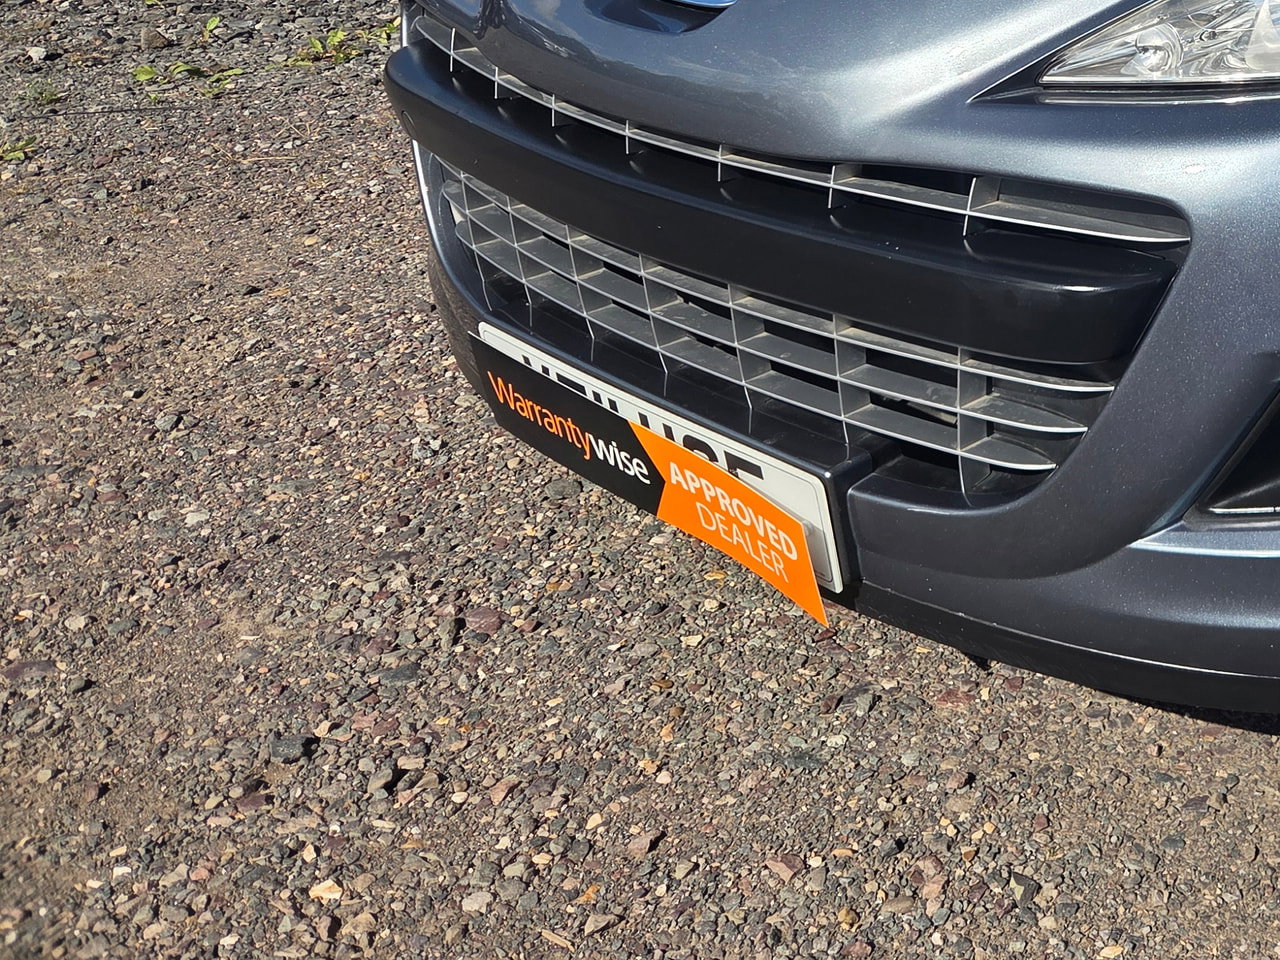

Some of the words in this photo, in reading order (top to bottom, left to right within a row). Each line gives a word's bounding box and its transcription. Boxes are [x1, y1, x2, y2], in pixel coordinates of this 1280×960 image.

[486, 370, 651, 485] Warrantywise
[669, 461, 798, 561] APPROVED
[694, 502, 789, 583] DEALER
